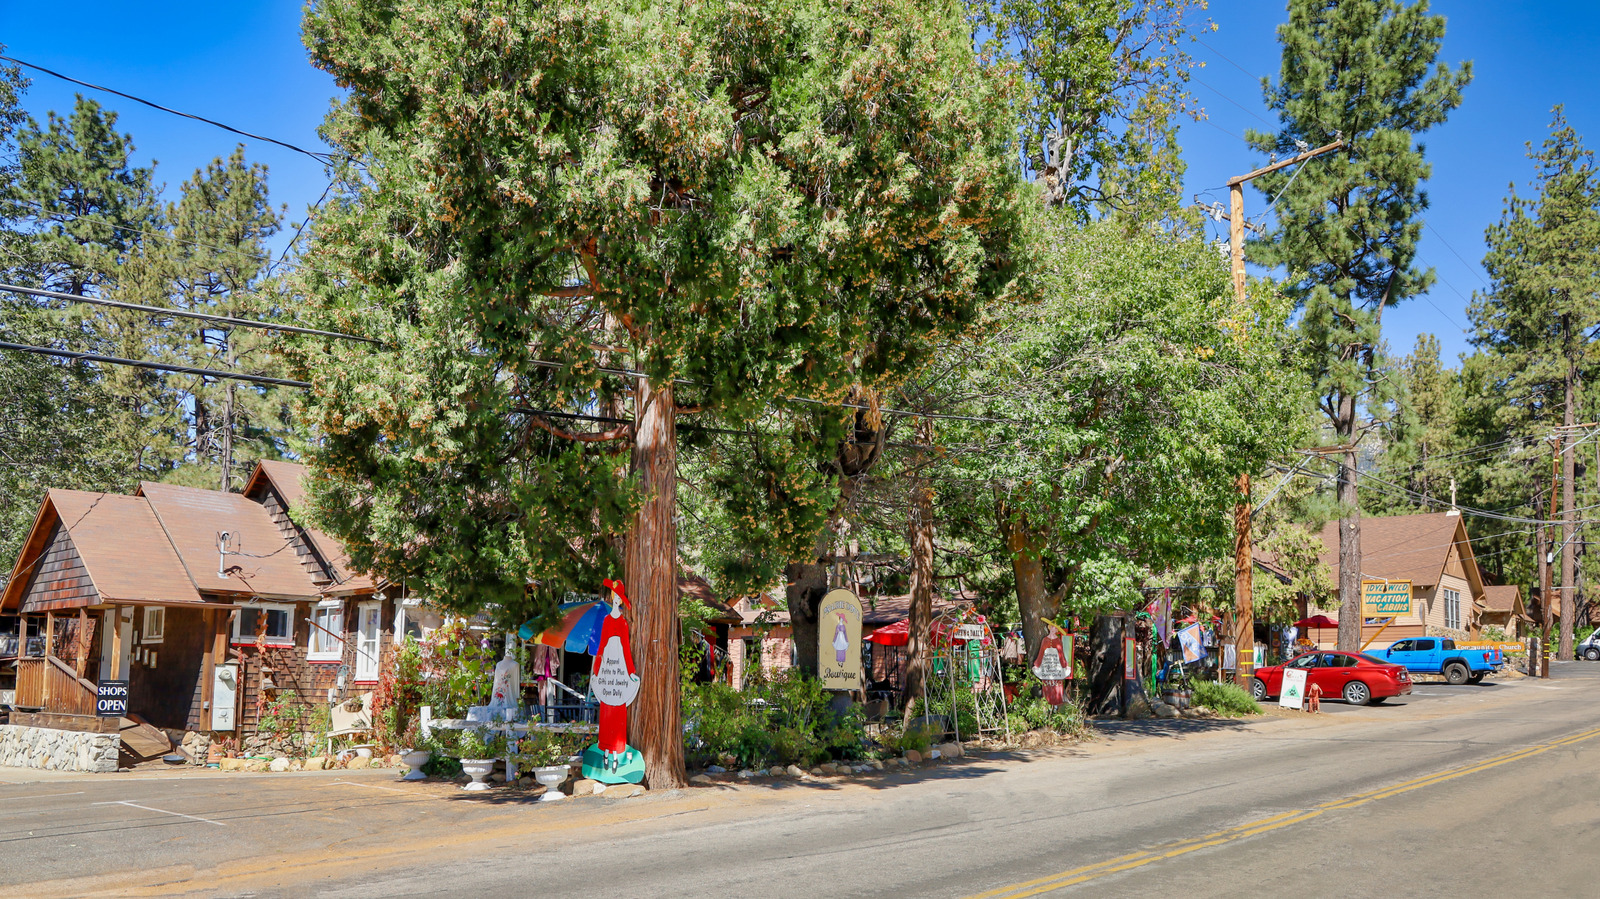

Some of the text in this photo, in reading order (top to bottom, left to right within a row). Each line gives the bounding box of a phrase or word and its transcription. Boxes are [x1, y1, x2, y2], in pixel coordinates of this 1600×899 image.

[1366, 584, 1409, 592] IDYLWILD
[1366, 594, 1408, 603] VACATION
[1377, 603, 1408, 611] CABINS
[606, 657, 620, 666] Apparel
[824, 667, 857, 682] Boutique
[598, 677, 606, 685] Gifts
[615, 679, 629, 688] Jewelry
[98, 686, 127, 696] SHOPS
[602, 688, 622, 698] Open Daily
[98, 699, 126, 711] OPEN
